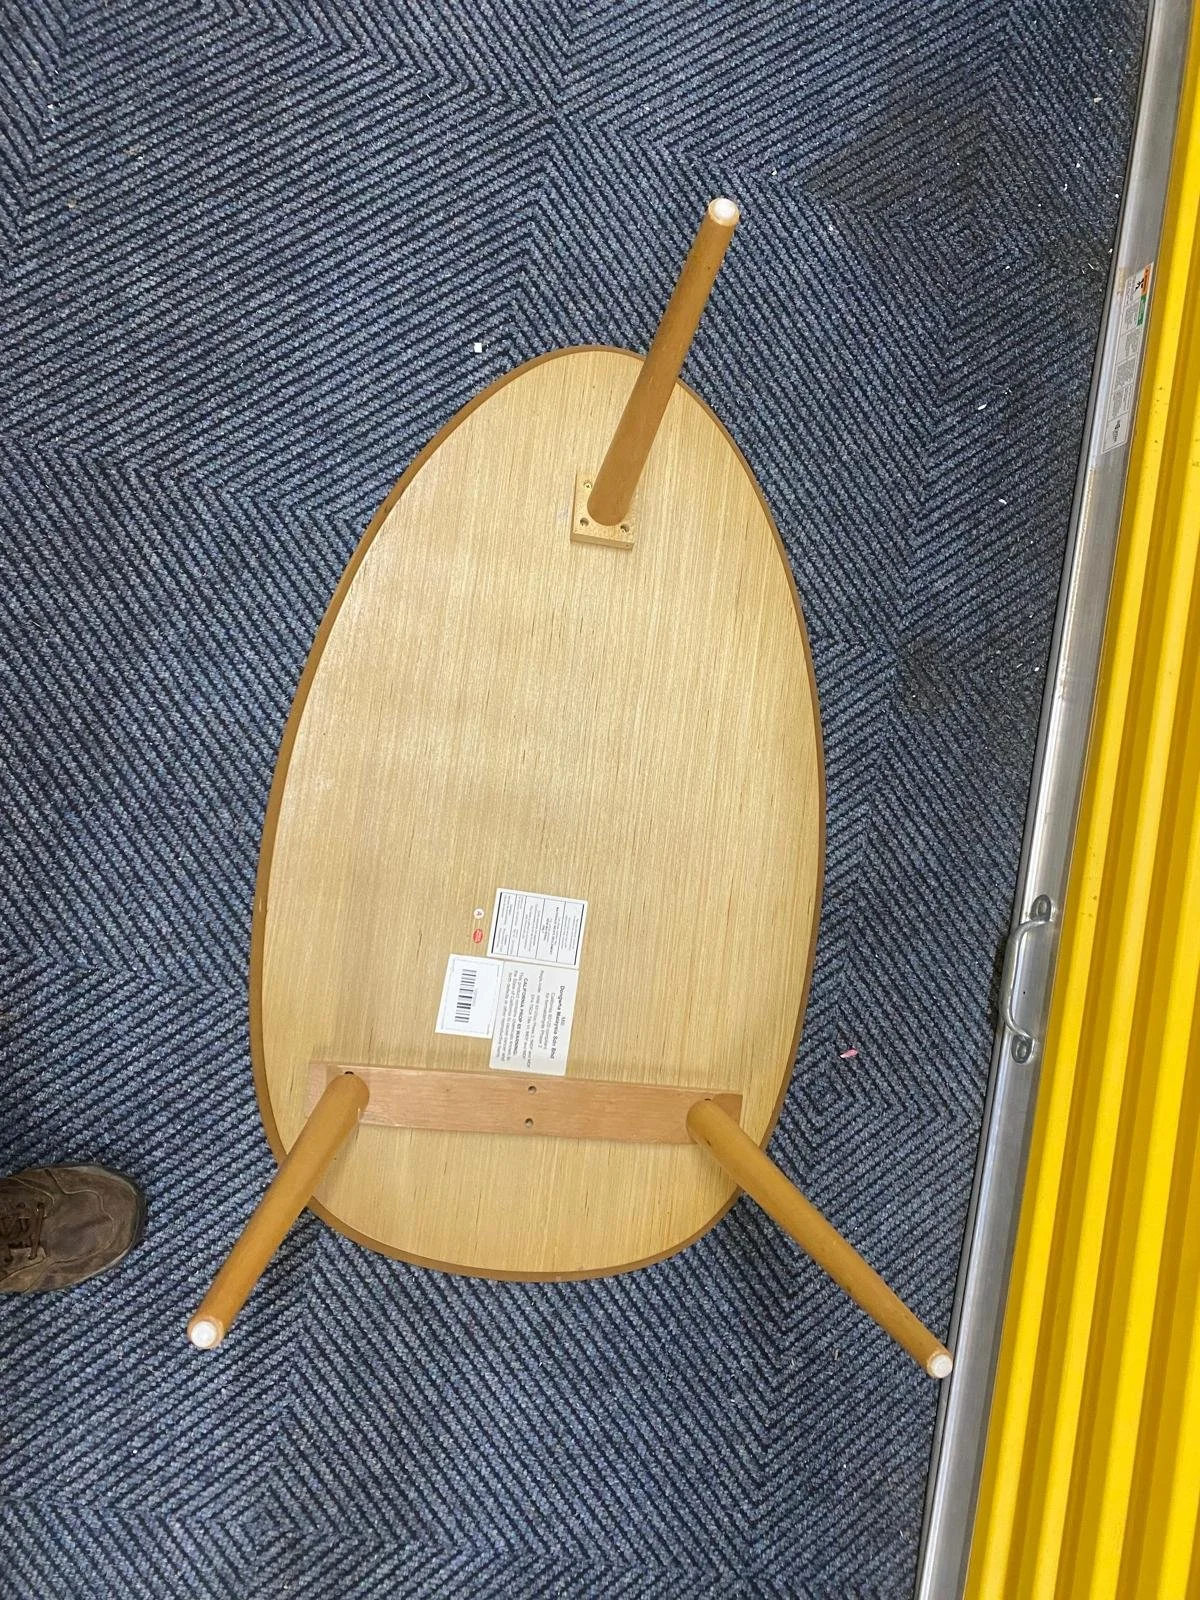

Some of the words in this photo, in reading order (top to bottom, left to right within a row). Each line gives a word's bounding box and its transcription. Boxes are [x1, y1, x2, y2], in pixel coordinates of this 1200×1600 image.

[520, 978, 528, 1008] CALIFORNIA
[557, 985, 565, 1010] Dongwha
[553, 1011, 561, 1035] Malaysia
